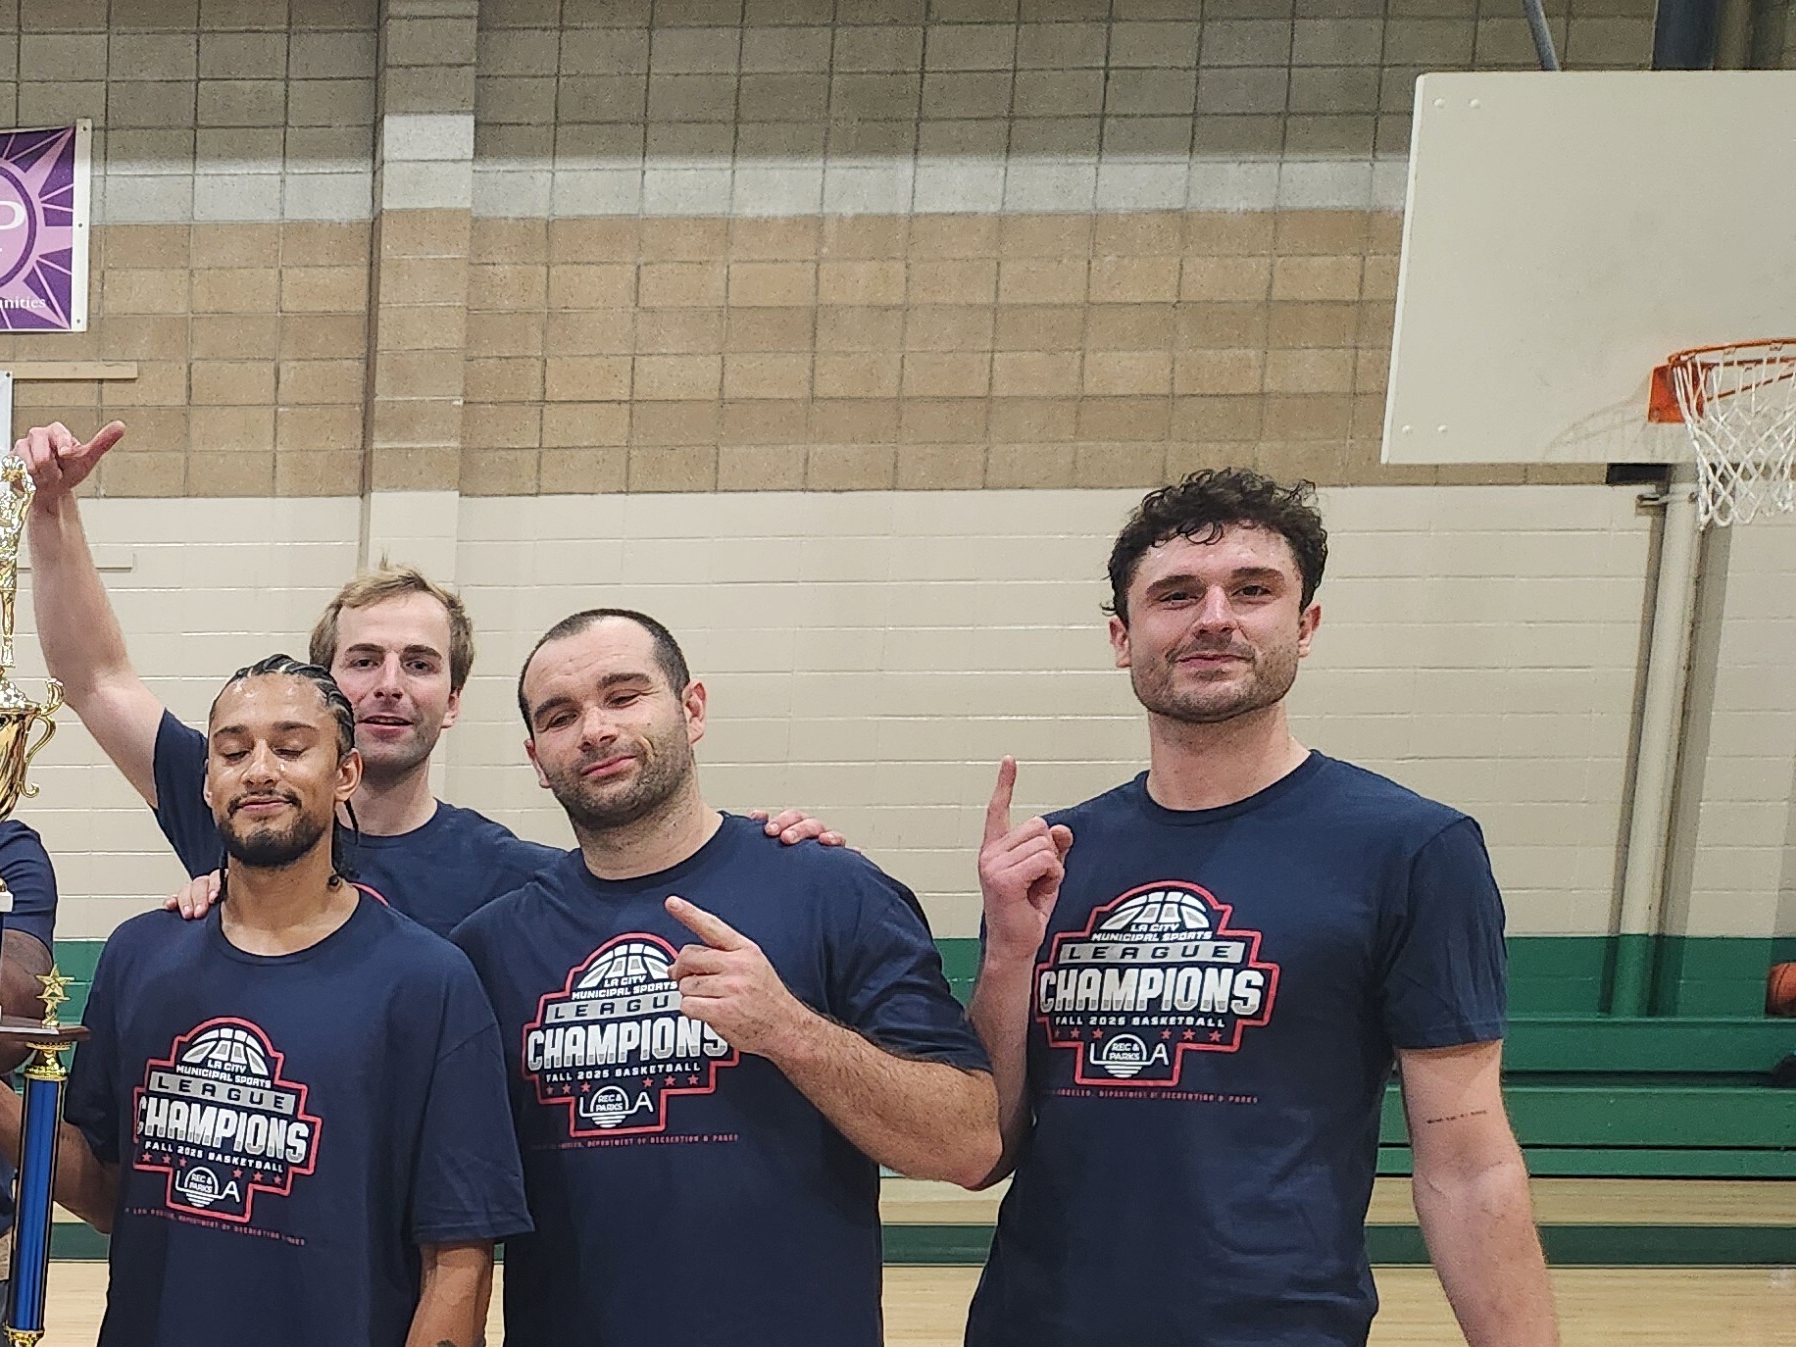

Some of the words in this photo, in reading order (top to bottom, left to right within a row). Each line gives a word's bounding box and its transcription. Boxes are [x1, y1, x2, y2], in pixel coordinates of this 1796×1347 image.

[1091, 932, 1158, 942] MUNICIPAL
[1162, 930, 1213, 941] SPORTS
[1149, 922, 1180, 932] CITY
[1069, 944, 1232, 960] LEAGUE
[571, 988, 631, 1000] MUNICIPAL
[633, 981, 678, 995] SPORTS
[1040, 967, 1265, 1016] CHAMPIONS
[555, 994, 669, 1020] LEAGU
[1055, 1016, 1083, 1026] FALL
[1131, 1015, 1226, 1028] BASKETBALL
[176, 1065, 233, 1083] MUNICIPAL
[234, 1074, 272, 1089] SPORTS
[615, 1063, 701, 1078] BASKETBALL
[157, 1076, 285, 1110] LEAGUE
[207, 1151, 284, 1174] BASKETBALL
